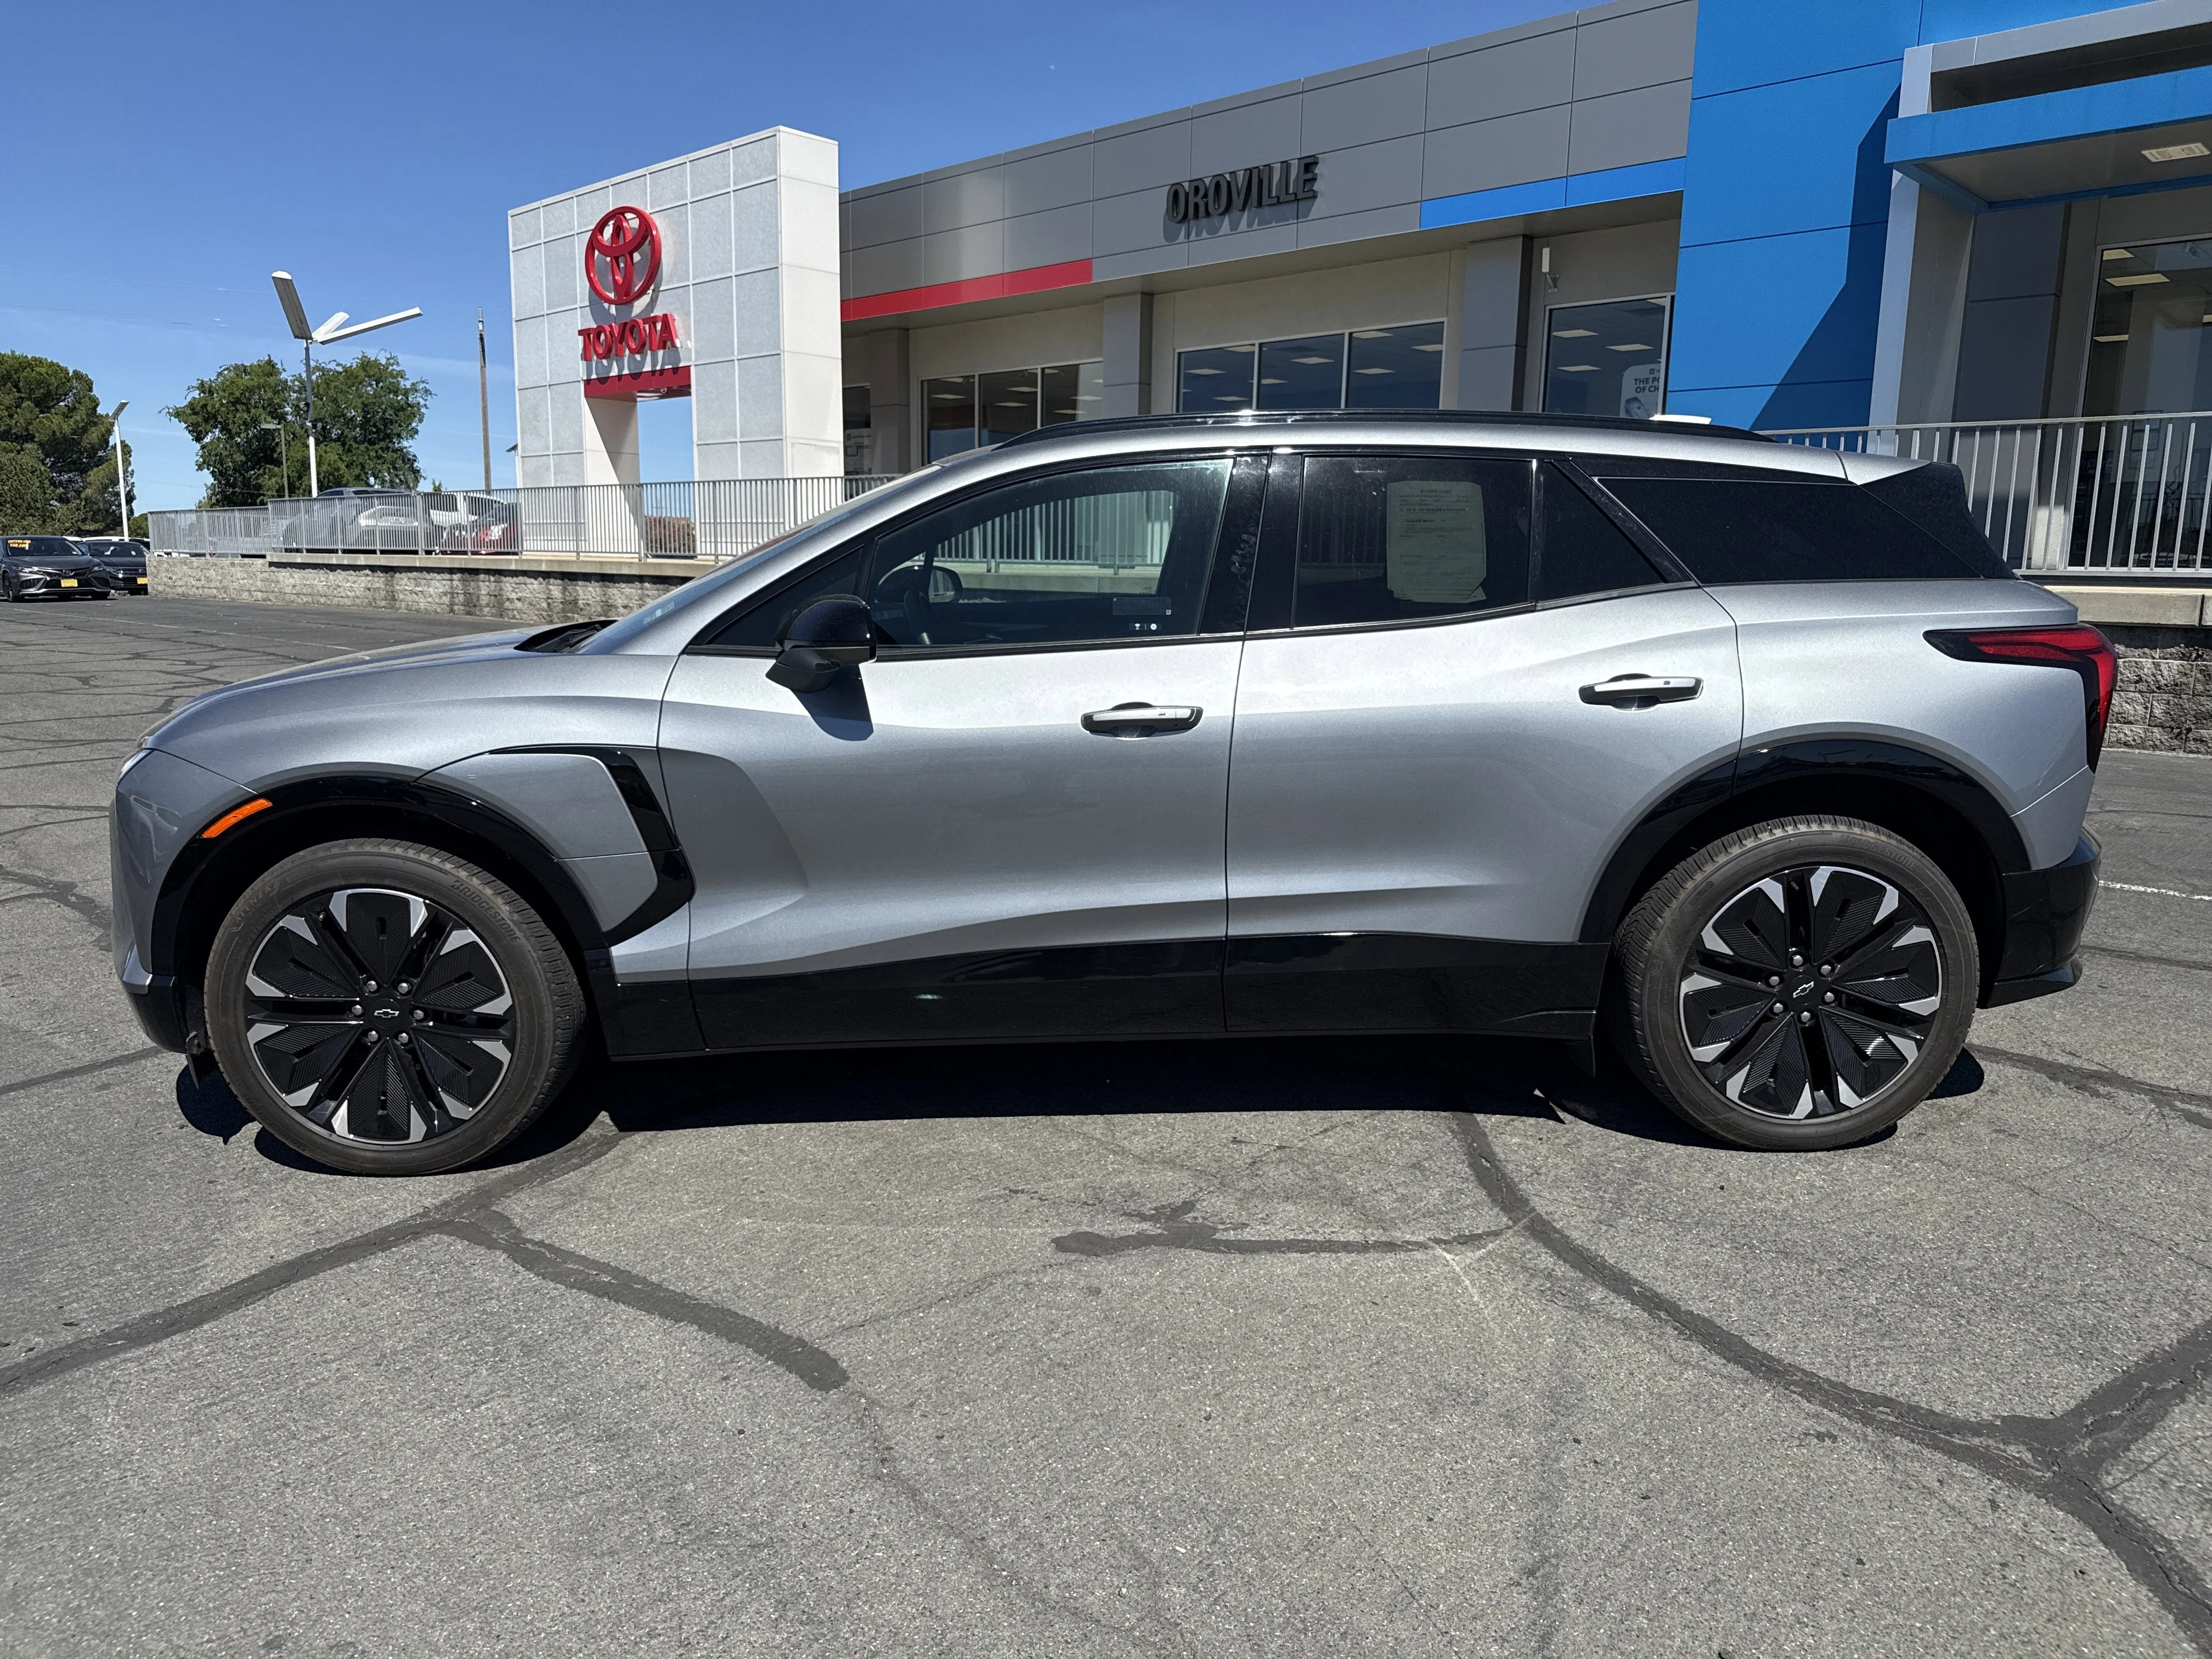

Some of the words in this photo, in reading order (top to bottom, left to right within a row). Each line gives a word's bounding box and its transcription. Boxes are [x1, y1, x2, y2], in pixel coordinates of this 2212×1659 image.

[1166, 156, 1319, 223] OROVILLE
[578, 313, 679, 362] TOYOTA
[1839, 833, 1918, 870] BRIDGESTONE
[450, 879, 521, 943] BRIDGESTONE
